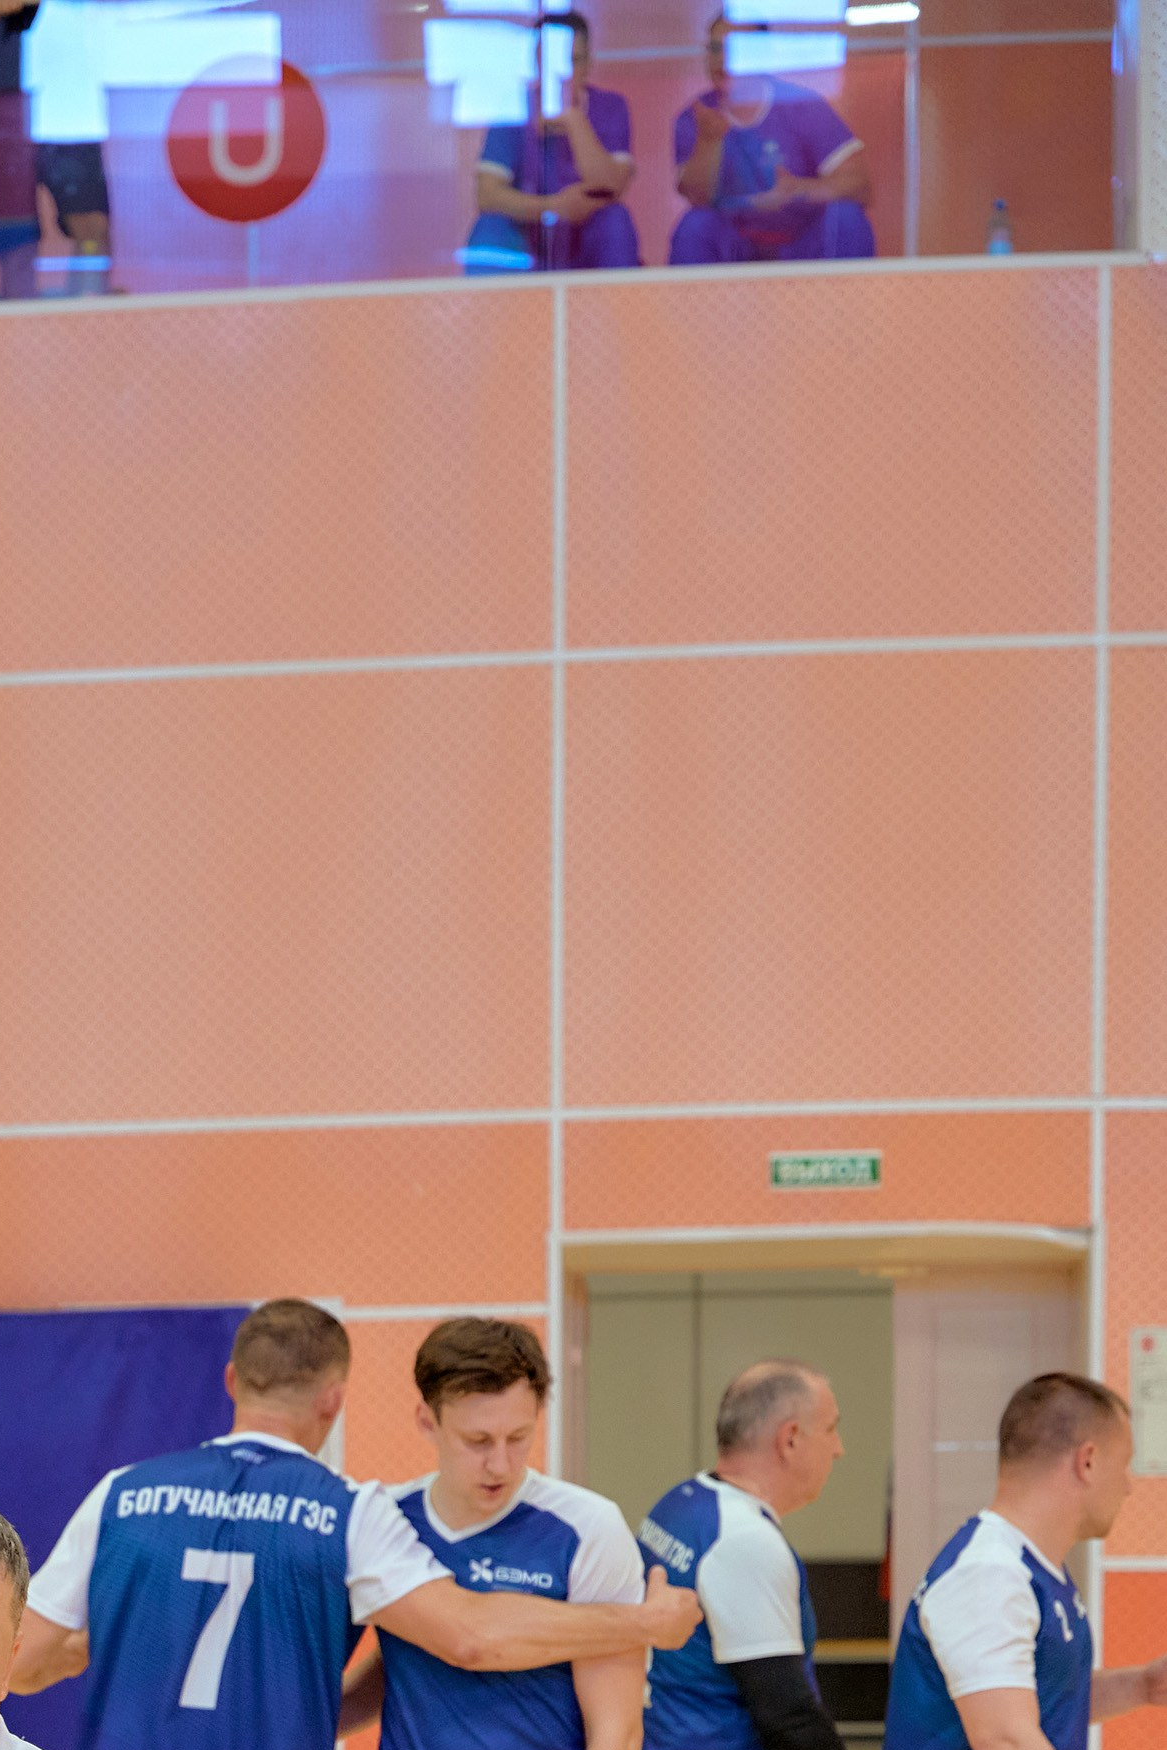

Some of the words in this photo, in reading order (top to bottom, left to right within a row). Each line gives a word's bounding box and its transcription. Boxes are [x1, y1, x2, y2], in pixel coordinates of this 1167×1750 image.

[117, 1485, 289, 1523] БОГУЧАНСКАЯ
[288, 1496, 338, 1536] ГЭС
[179, 1547, 255, 1711] 7
